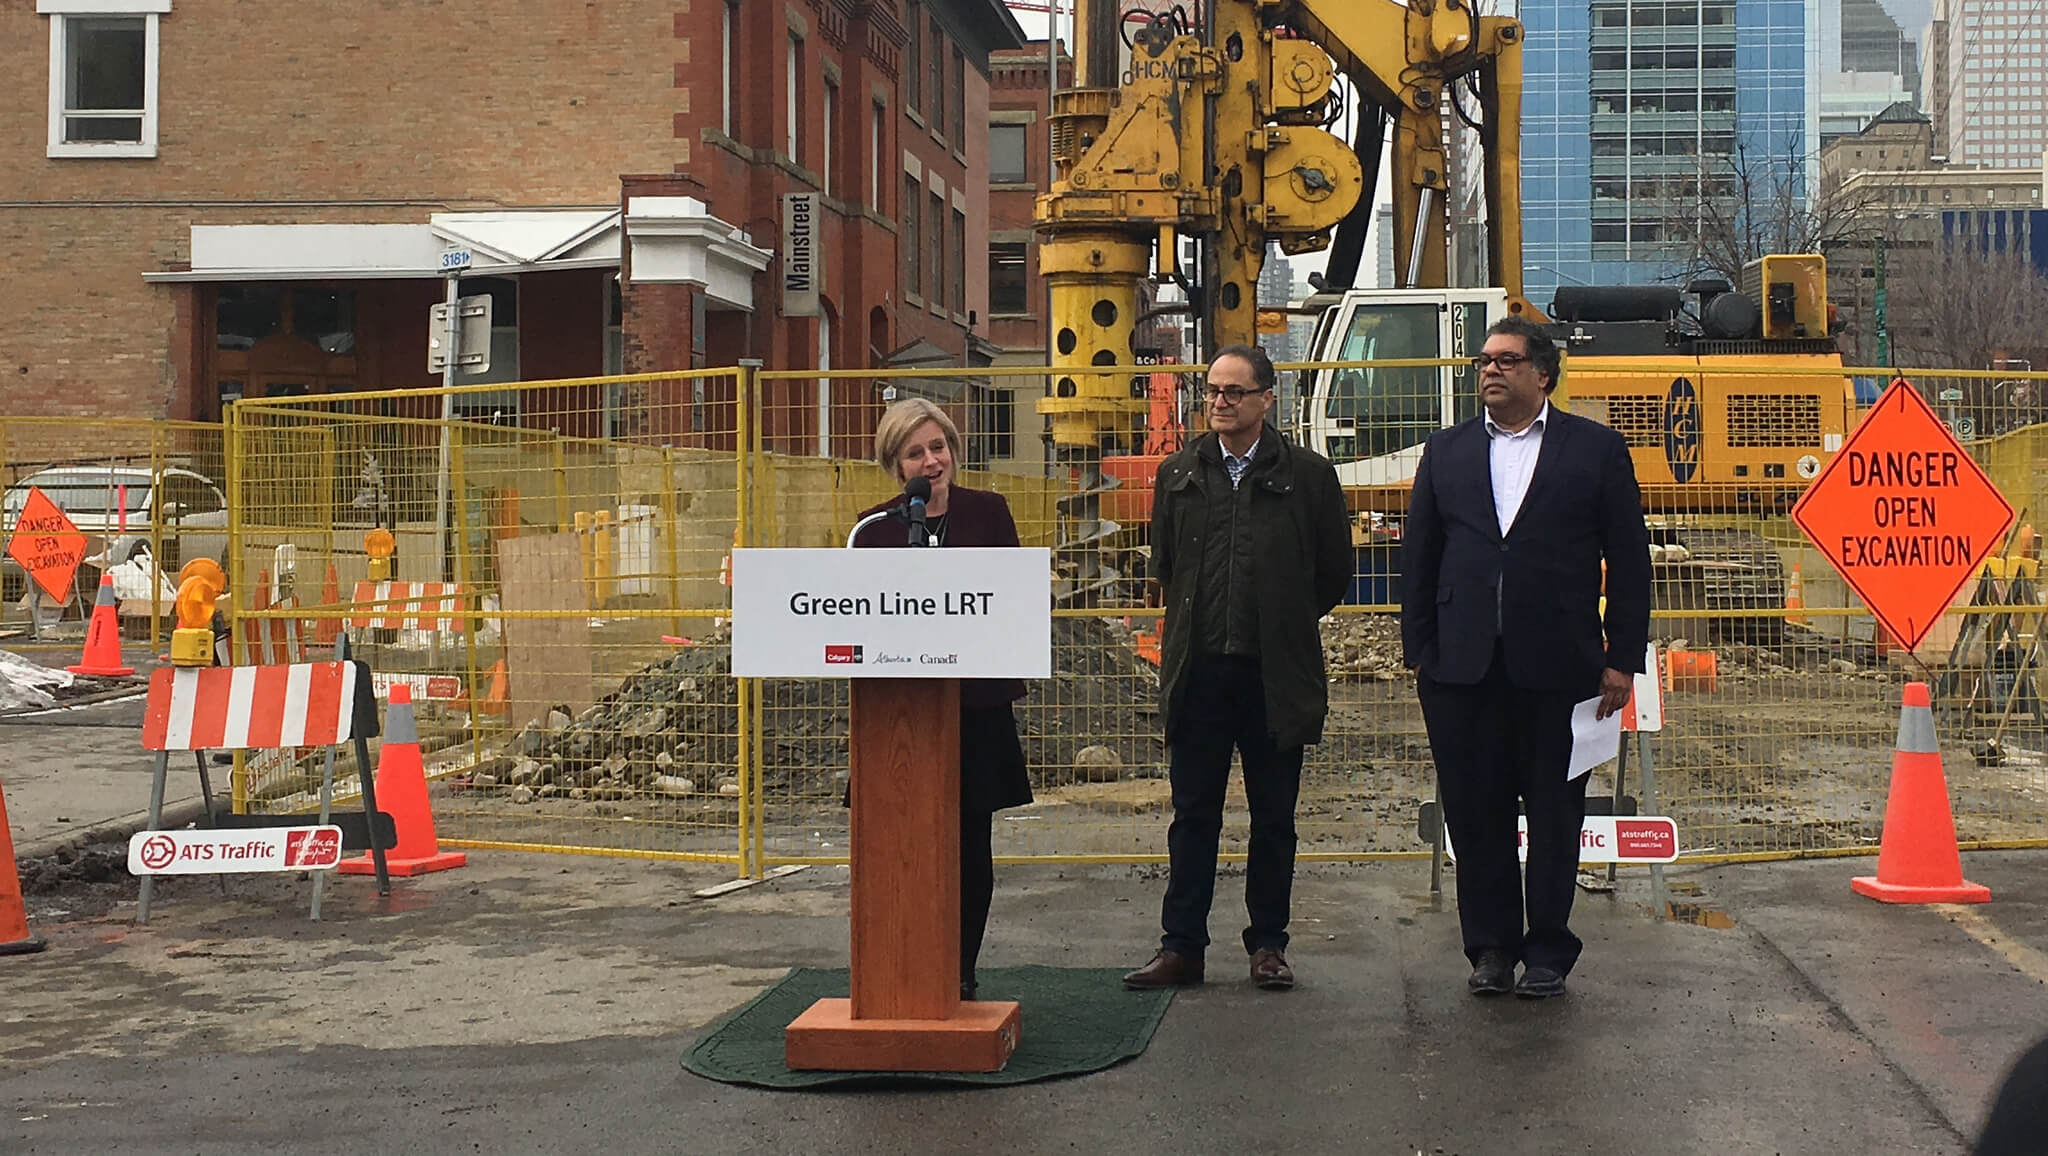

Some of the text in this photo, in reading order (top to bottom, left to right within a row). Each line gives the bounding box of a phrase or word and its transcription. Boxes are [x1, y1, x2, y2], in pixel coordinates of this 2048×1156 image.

[786, 195, 810, 292] Mainstreet
[442, 252, 466, 267] 3181
[1849, 451, 1959, 487] DANGER
[1874, 497, 1936, 528] OPEN
[21, 515, 64, 532] DANGER
[35, 537, 59, 552] OPEN
[1841, 535, 1971, 567] EXCAVATION
[790, 592, 994, 616] Green Line LRT
[919, 653, 958, 664] Canada
[179, 843, 214, 860] ATS
[219, 841, 276, 859] Traffic
